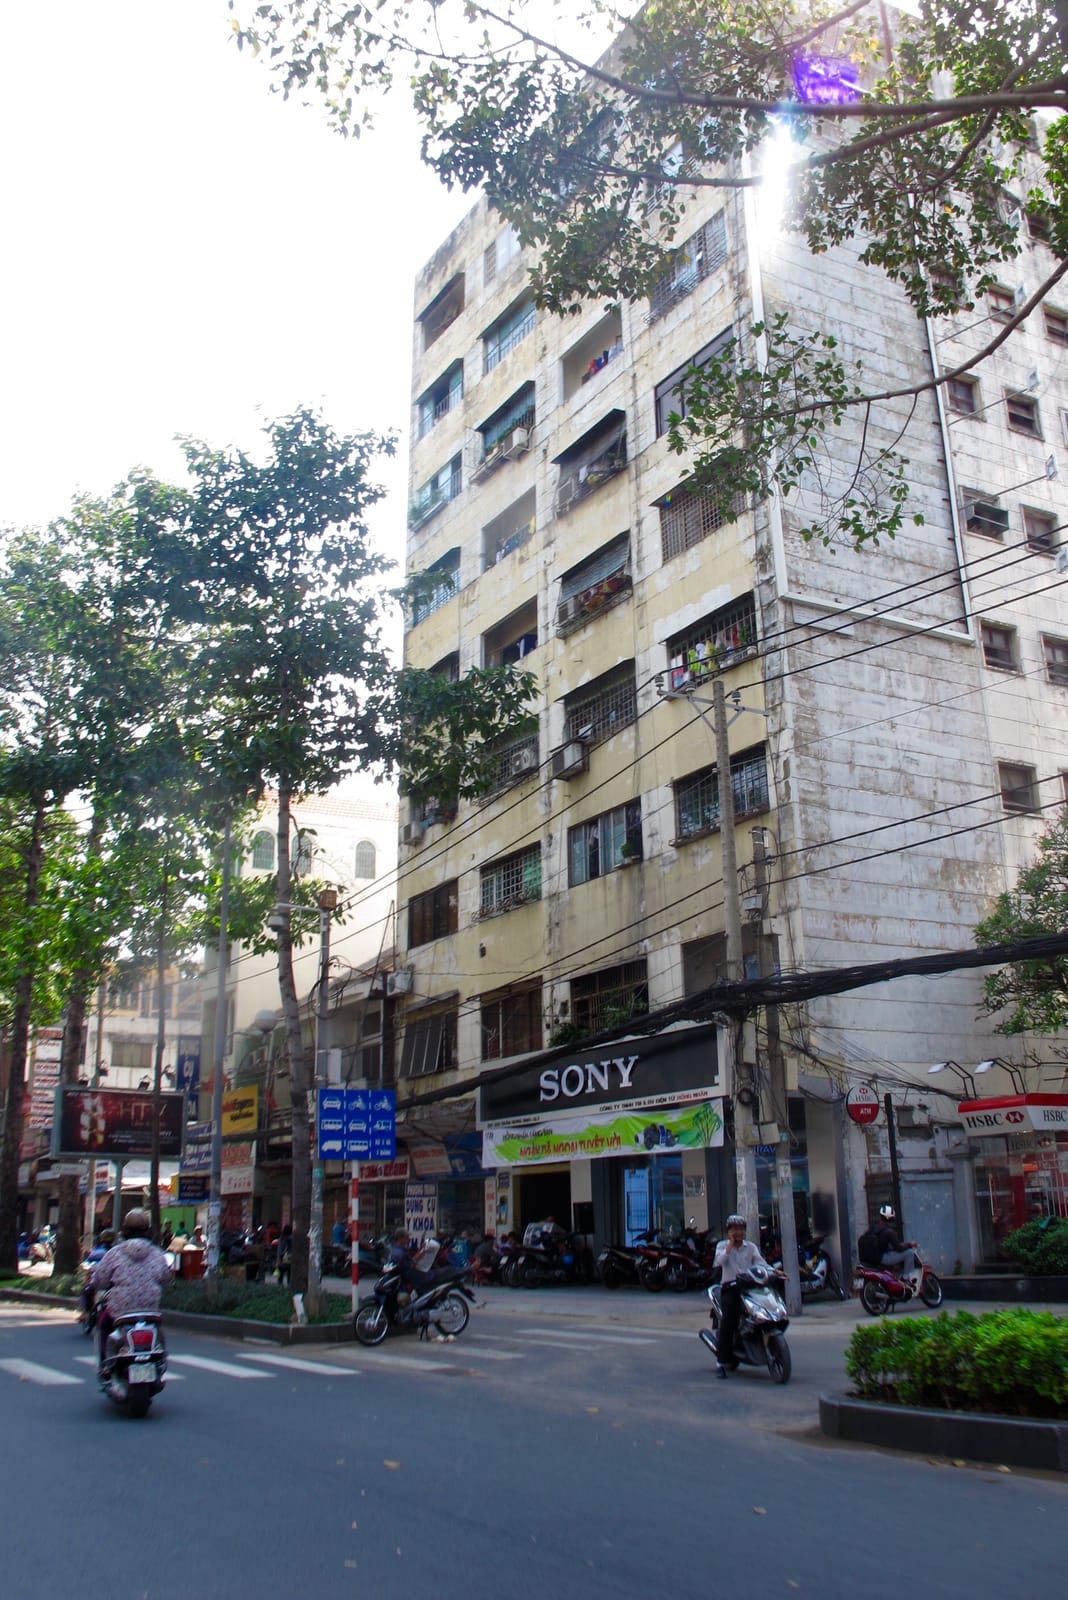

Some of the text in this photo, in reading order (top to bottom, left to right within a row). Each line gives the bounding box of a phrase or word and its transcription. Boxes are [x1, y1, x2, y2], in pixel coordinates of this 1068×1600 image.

[539, 1055, 639, 1102] SONY
[855, 1094, 874, 1103] HSBC
[860, 1107, 872, 1116] ATM
[1043, 1110, 1068, 1123] HSBC
[966, 1112, 1004, 1129] HSBC
[406, 1216, 435, 1231] Y KHOA
